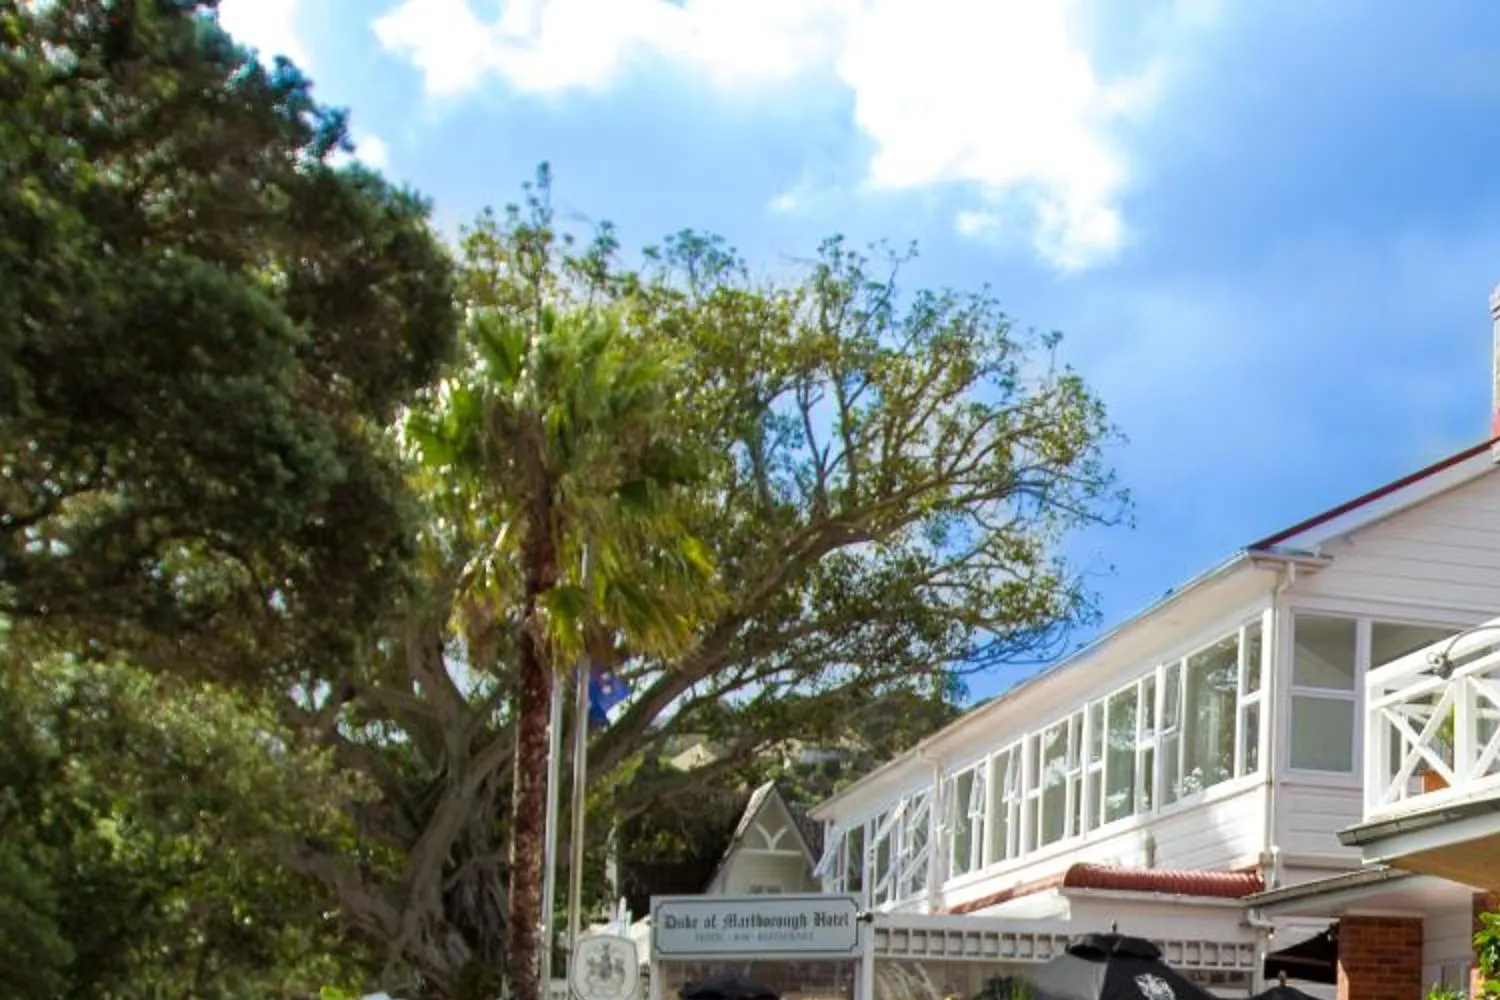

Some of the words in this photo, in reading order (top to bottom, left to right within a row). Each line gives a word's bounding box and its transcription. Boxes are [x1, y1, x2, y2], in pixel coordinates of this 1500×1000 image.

[664, 913, 698, 929] Duke
[703, 914, 717, 929] of
[721, 912, 808, 931] Marlborough
[813, 911, 850, 928] Hotel
